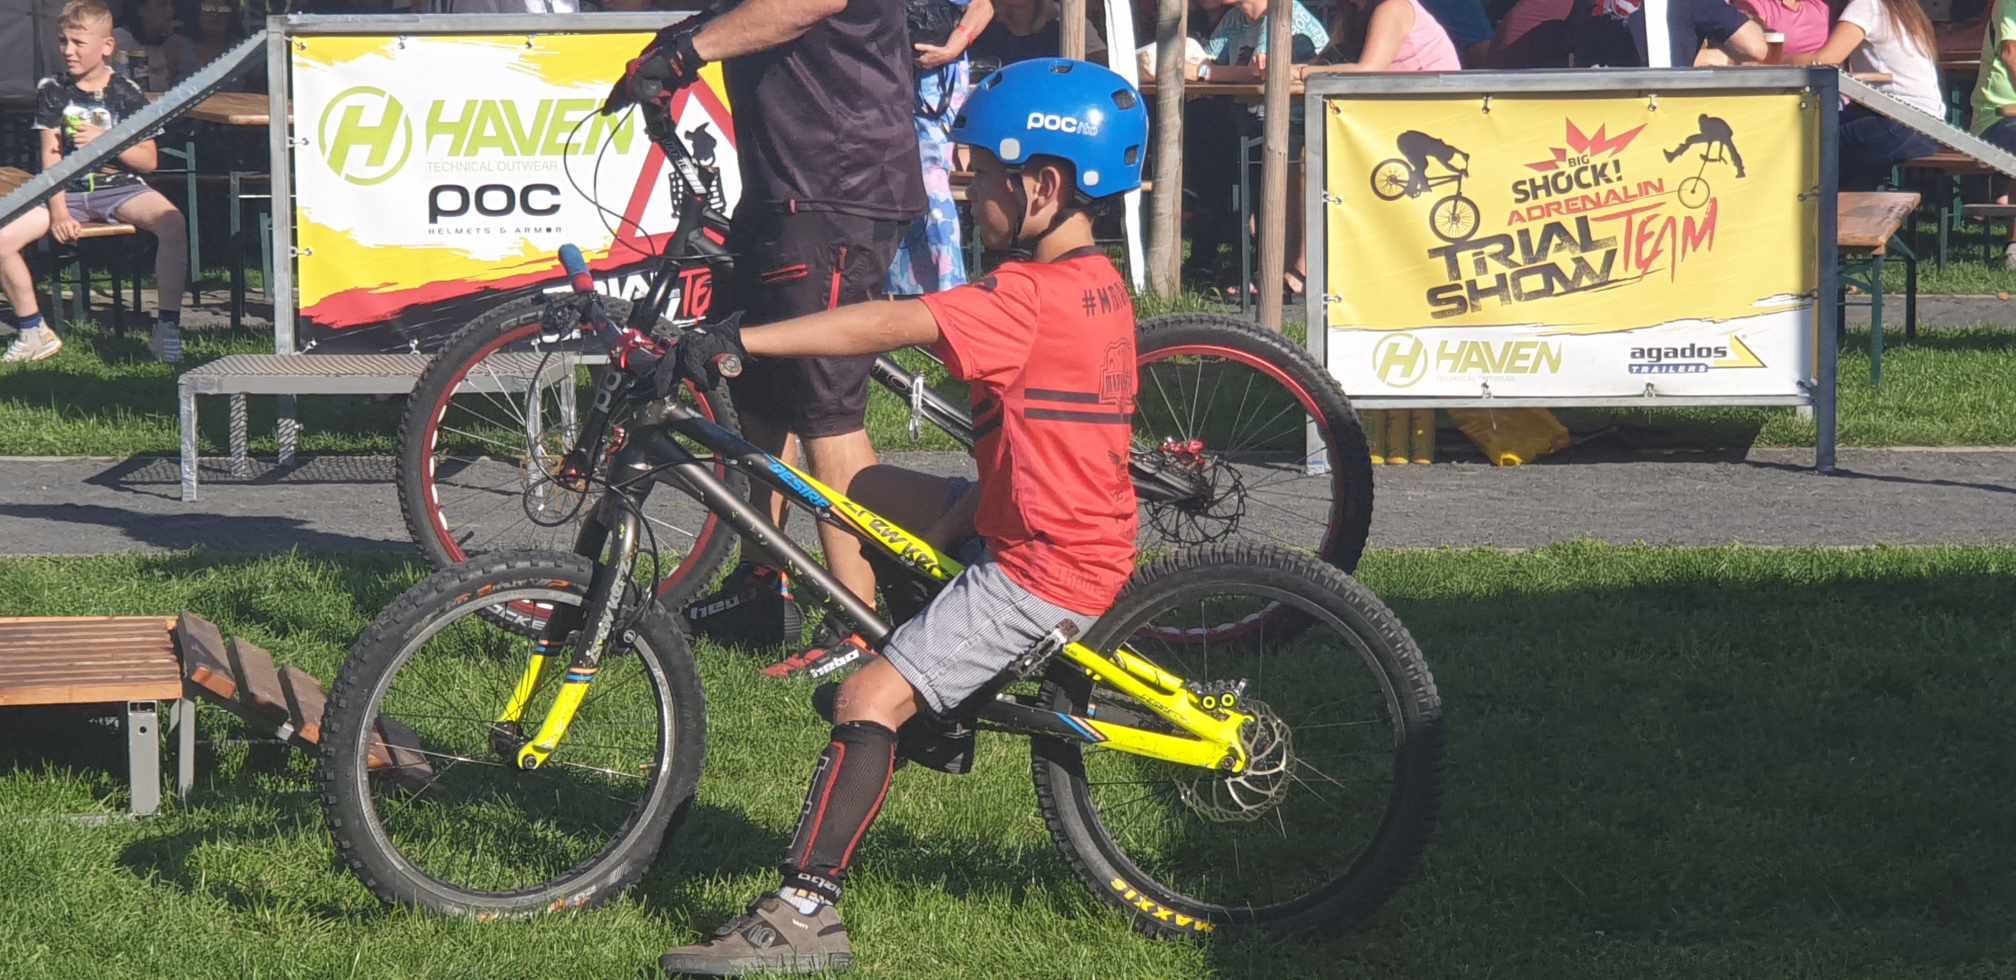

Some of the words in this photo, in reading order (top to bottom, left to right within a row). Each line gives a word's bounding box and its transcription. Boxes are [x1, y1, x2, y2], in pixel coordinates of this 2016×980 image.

[426, 98, 635, 157] HAVEN
[426, 160, 494, 173] TECHNICAL
[496, 160, 558, 172] OUTWEAR
[1567, 154, 1590, 168] BIG
[1511, 159, 1623, 204] SHOCK!
[1507, 177, 1665, 226] ADRENALIN
[428, 227, 491, 235] HELMETS
[514, 226, 562, 234] ARMOR
[1427, 215, 1618, 282] TRIAL
[1591, 196, 1718, 284] TEAM
[1427, 247, 1618, 319] SHOW
[1435, 340, 1563, 374] HAVEN
[1630, 343, 1728, 363] agados
[1630, 365, 1708, 374] TRAILERS
[809, 648, 861, 680] hebo
[1110, 878, 1217, 933] MAXXIS
